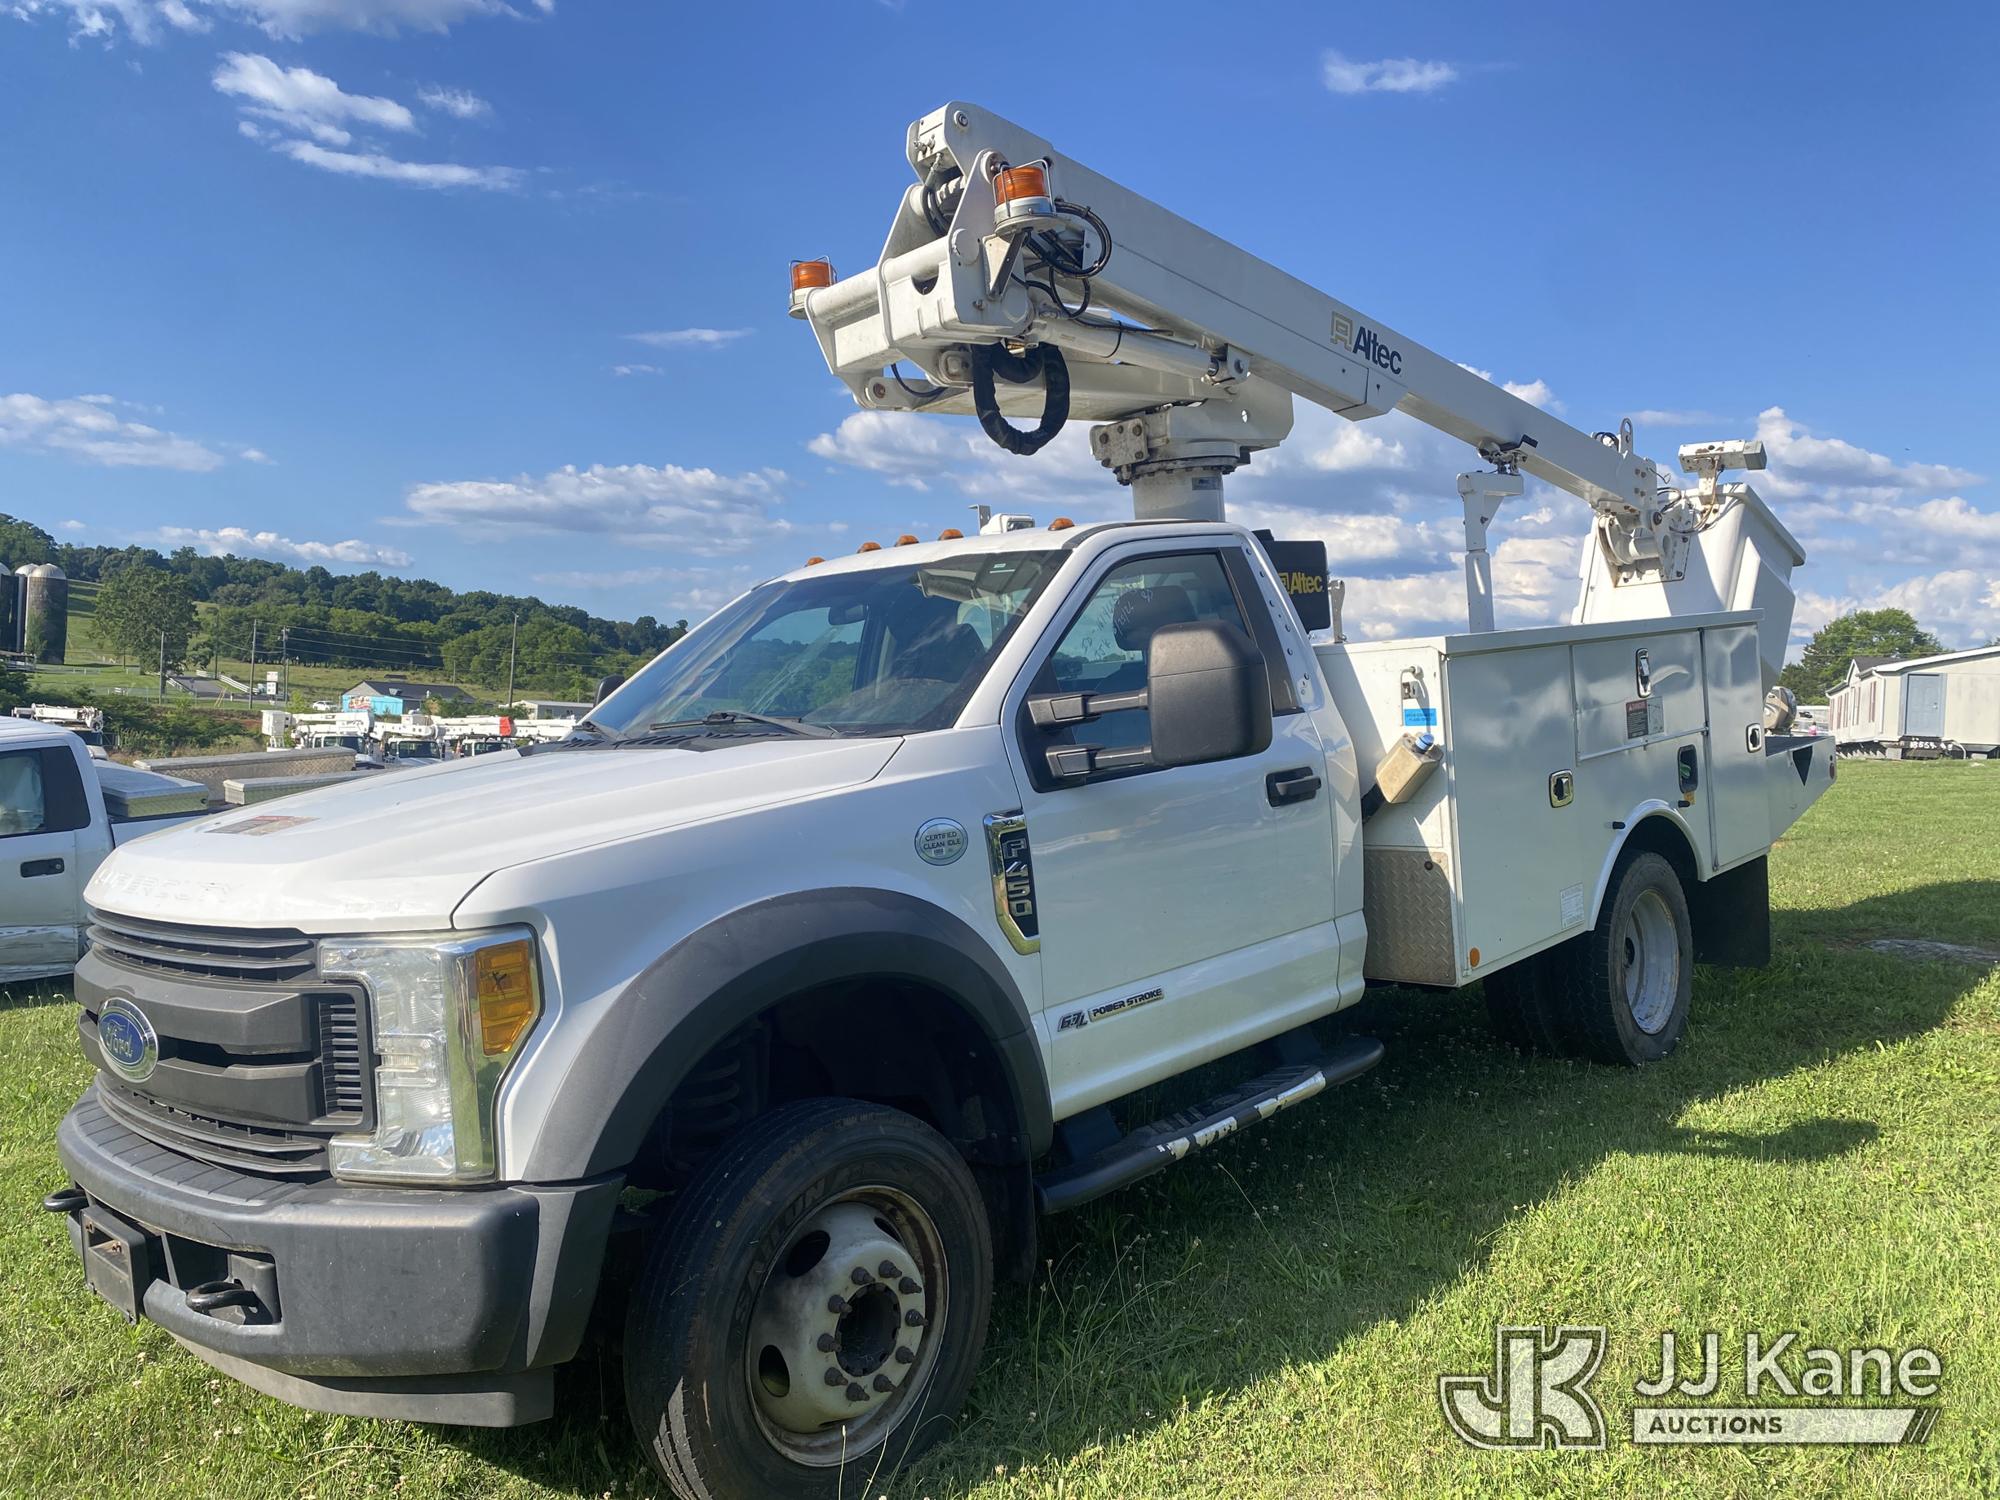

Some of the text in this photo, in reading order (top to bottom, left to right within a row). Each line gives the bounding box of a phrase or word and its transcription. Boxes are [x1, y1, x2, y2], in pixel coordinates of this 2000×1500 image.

[1353, 325, 1402, 375] Altec
[1290, 572, 1323, 594] Altec
[923, 838, 961, 850] CLEAN IDLE
[925, 831, 957, 842] CERTIFIED
[1092, 1000, 1126, 1017] POWER
[1126, 988, 1162, 1006] STROKE
[105, 1019, 133, 1058] Ford
